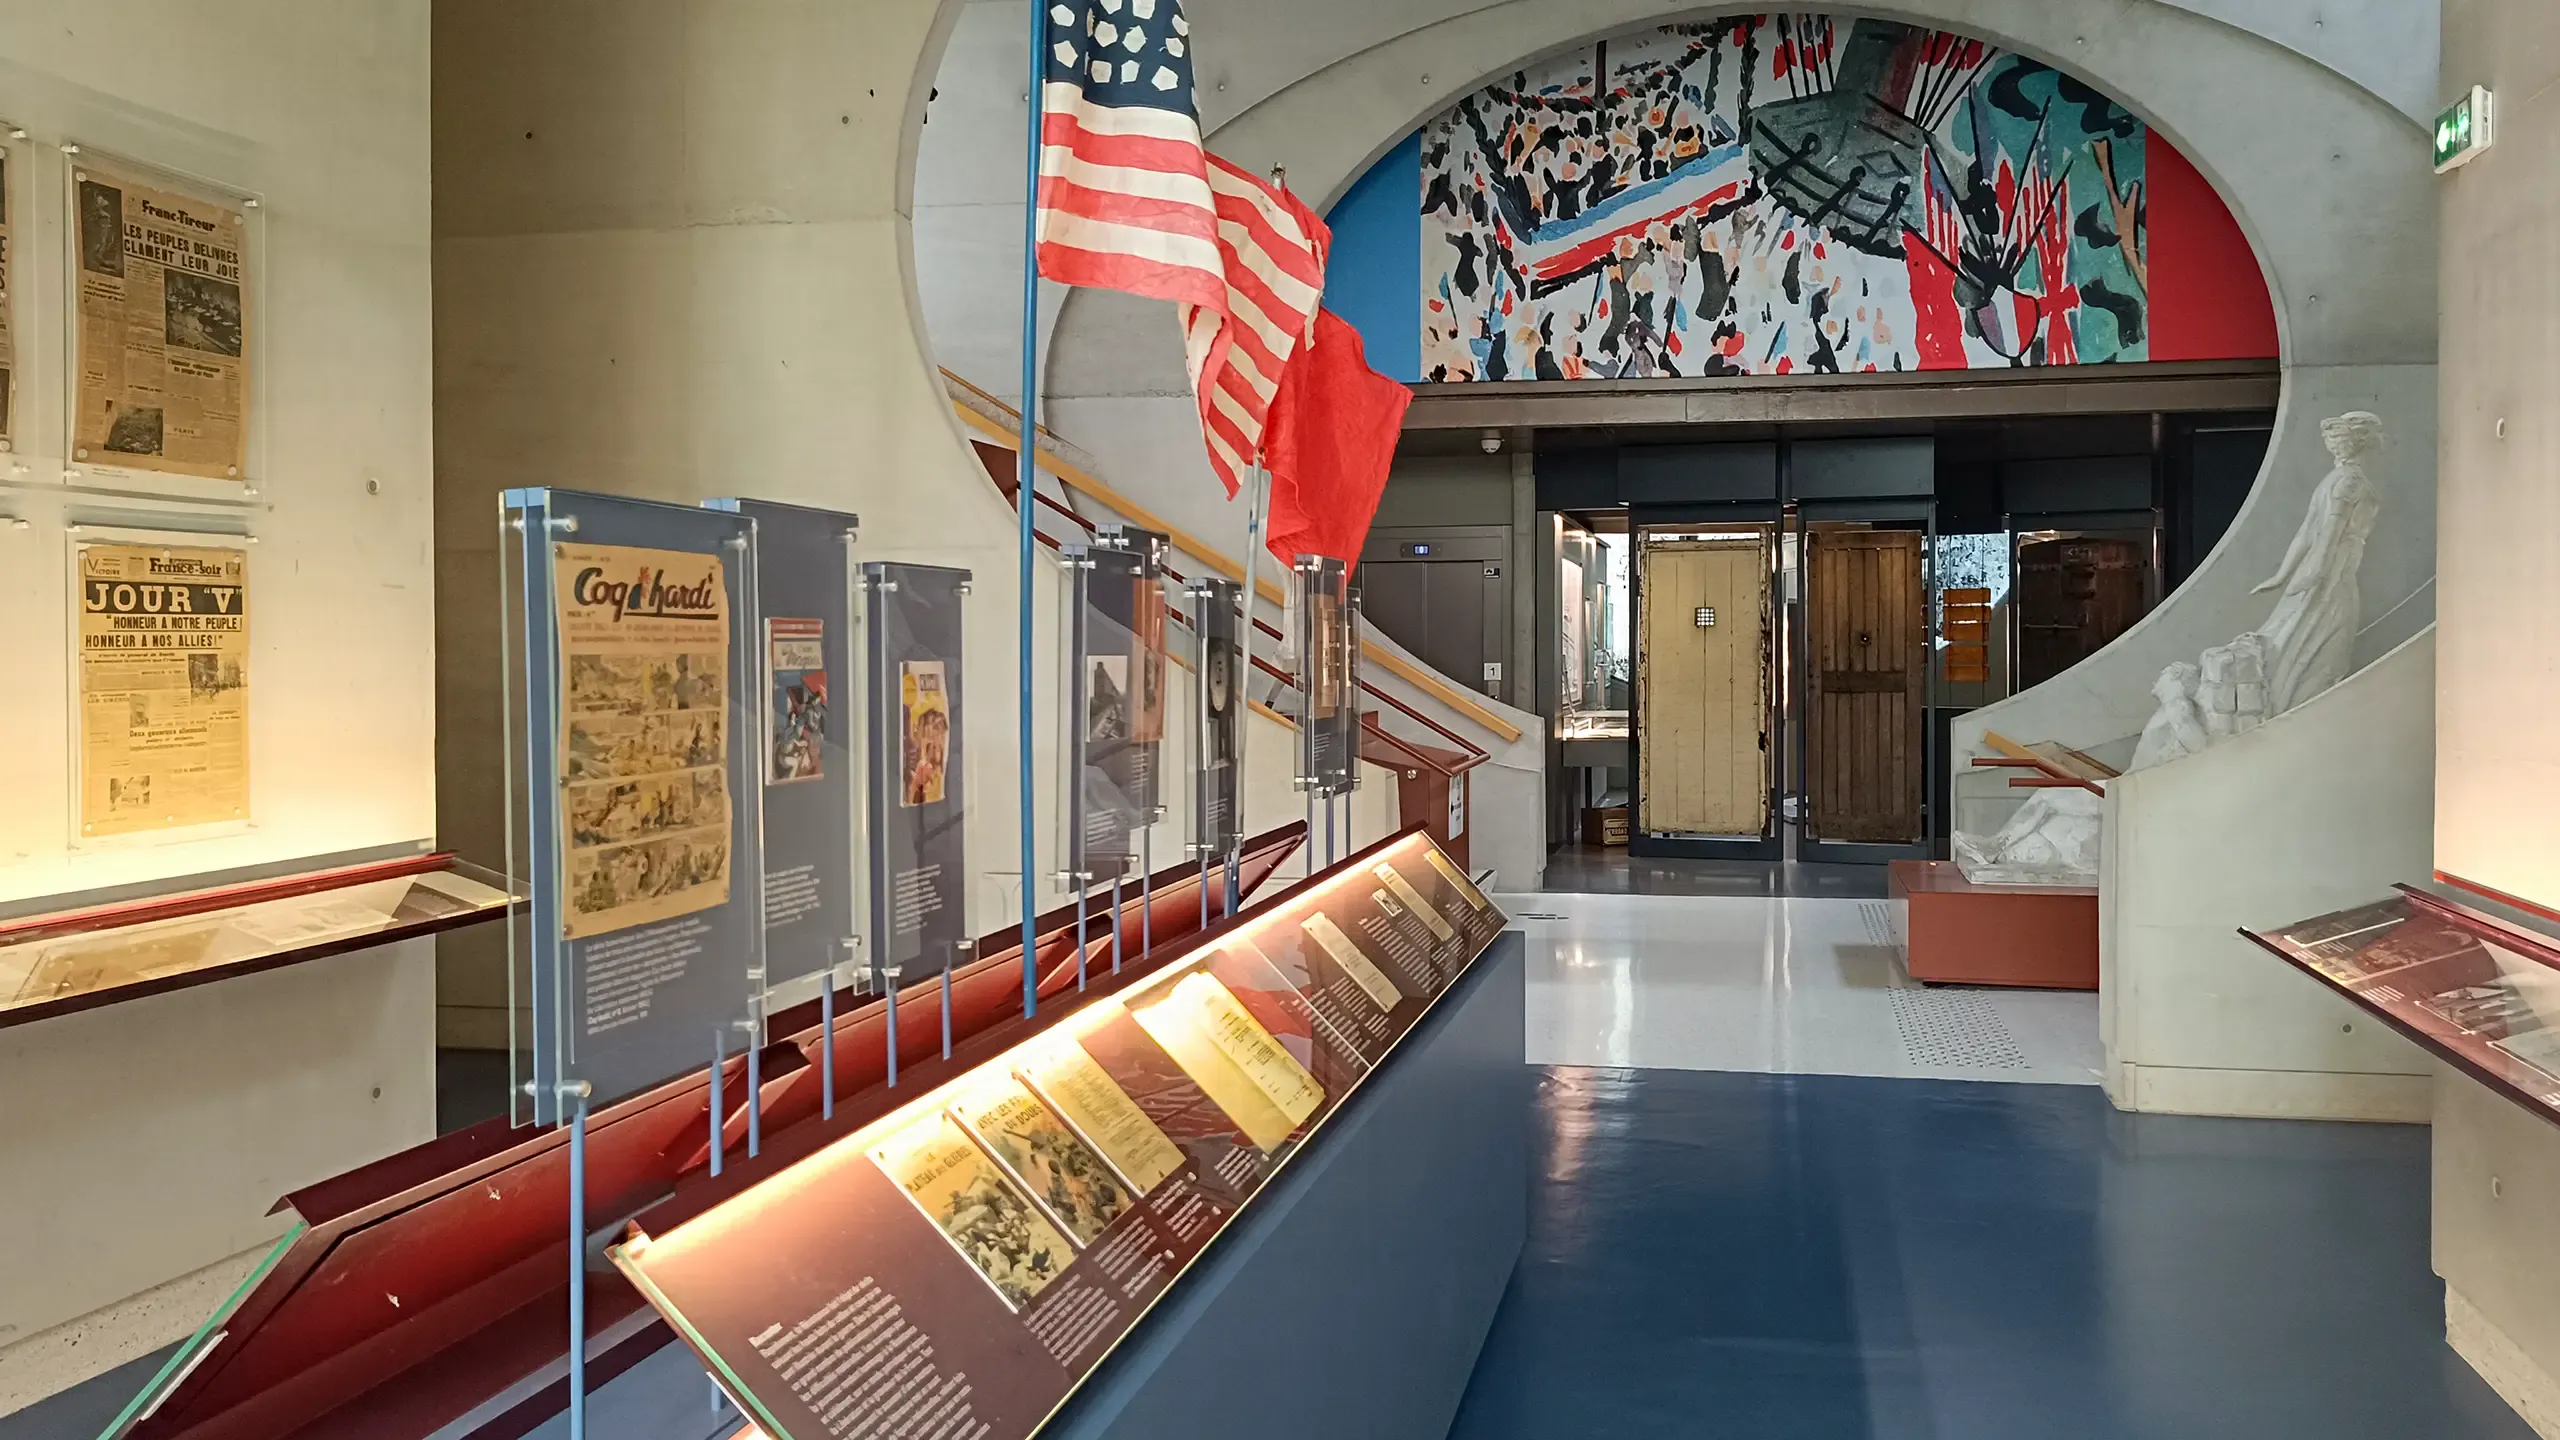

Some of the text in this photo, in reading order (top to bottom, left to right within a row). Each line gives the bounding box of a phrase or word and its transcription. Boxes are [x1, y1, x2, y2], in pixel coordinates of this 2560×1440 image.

[142, 199, 216, 232] Franc-Tireur
[123, 222, 239, 265] LES PEUPLES DELIVRES
[123, 239, 239, 280] CLAMENT LEUR JOIE
[149, 557, 222, 575] France-soir
[86, 583, 192, 613] JOUR
[574, 566, 716, 623] Coq hardi
[161, 616, 168, 629] A
[171, 616, 201, 629] NOTRE
[85, 634, 136, 648] HONNEUR
[141, 635, 148, 647] A
[152, 635, 173, 647] NOS
[1490, 667, 1496, 677] 1
[1015, 1103, 1044, 1126] DOUBS
